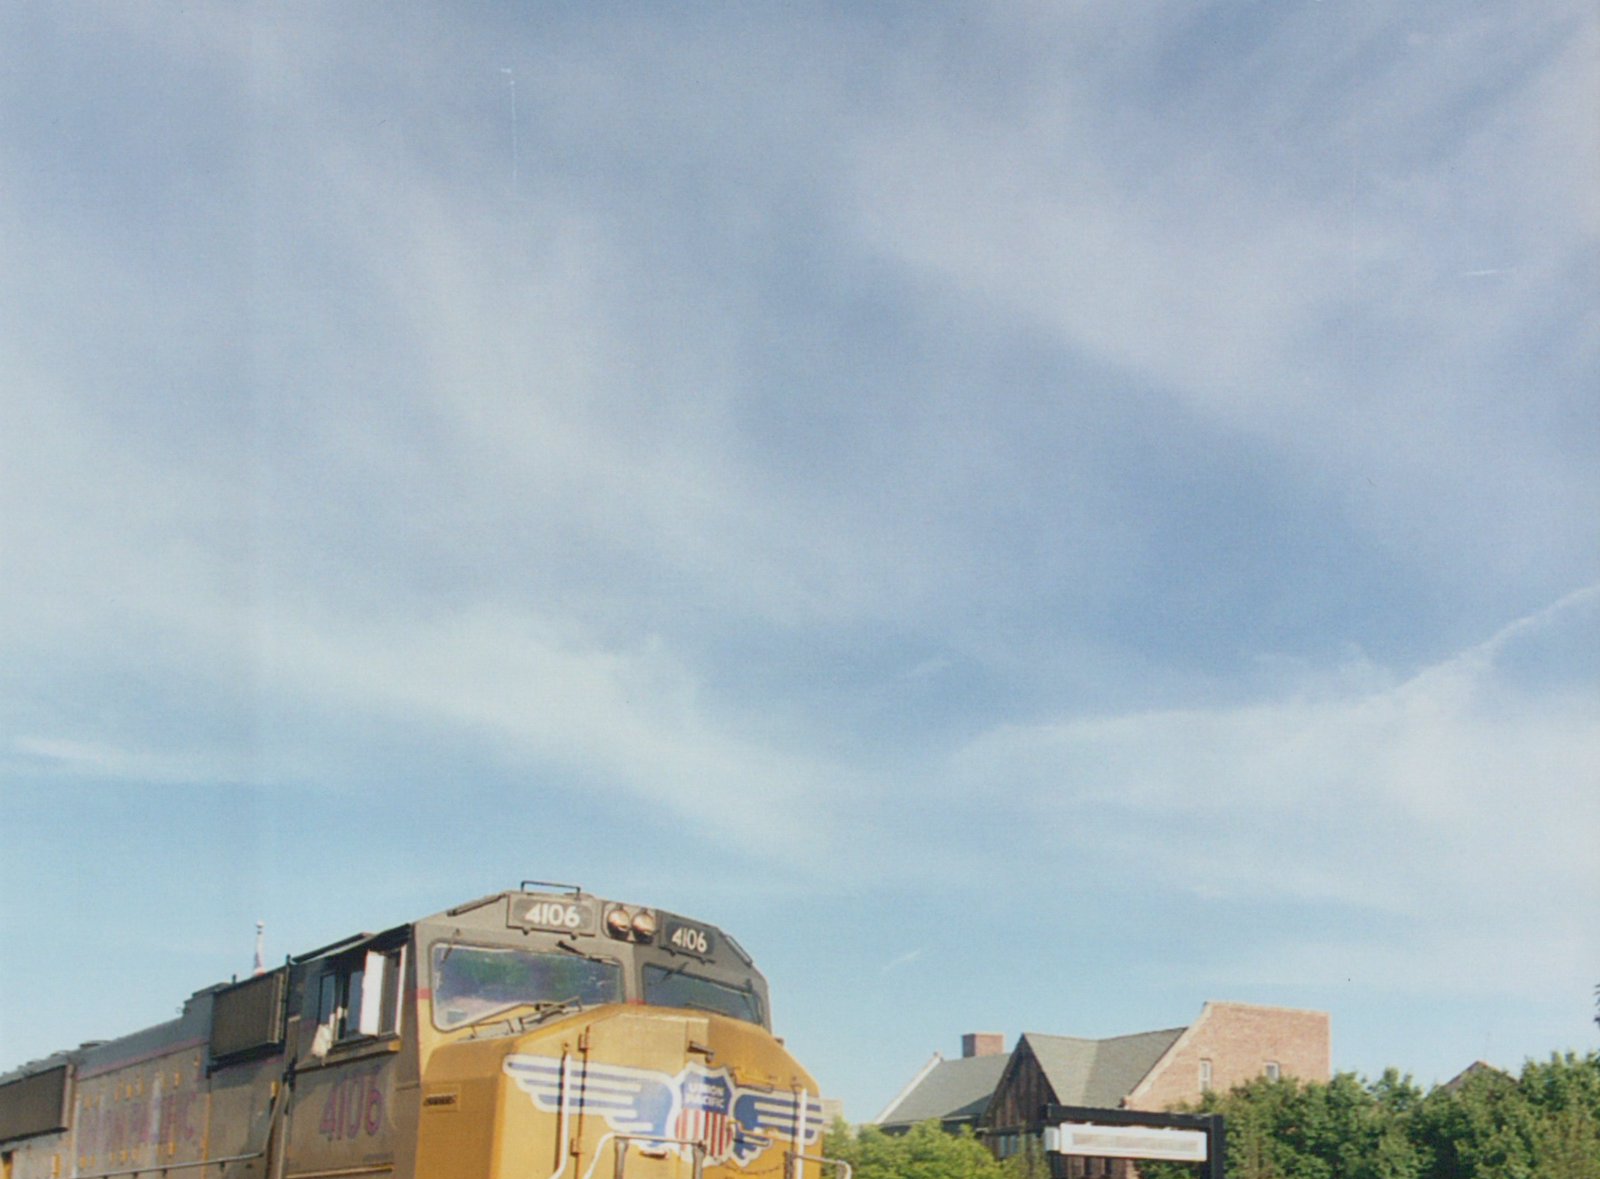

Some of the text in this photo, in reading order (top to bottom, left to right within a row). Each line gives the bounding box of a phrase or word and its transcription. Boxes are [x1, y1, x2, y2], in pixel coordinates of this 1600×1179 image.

[524, 903, 580, 928] 4106
[671, 927, 708, 953] 4106
[319, 1064, 385, 1141] 4106
